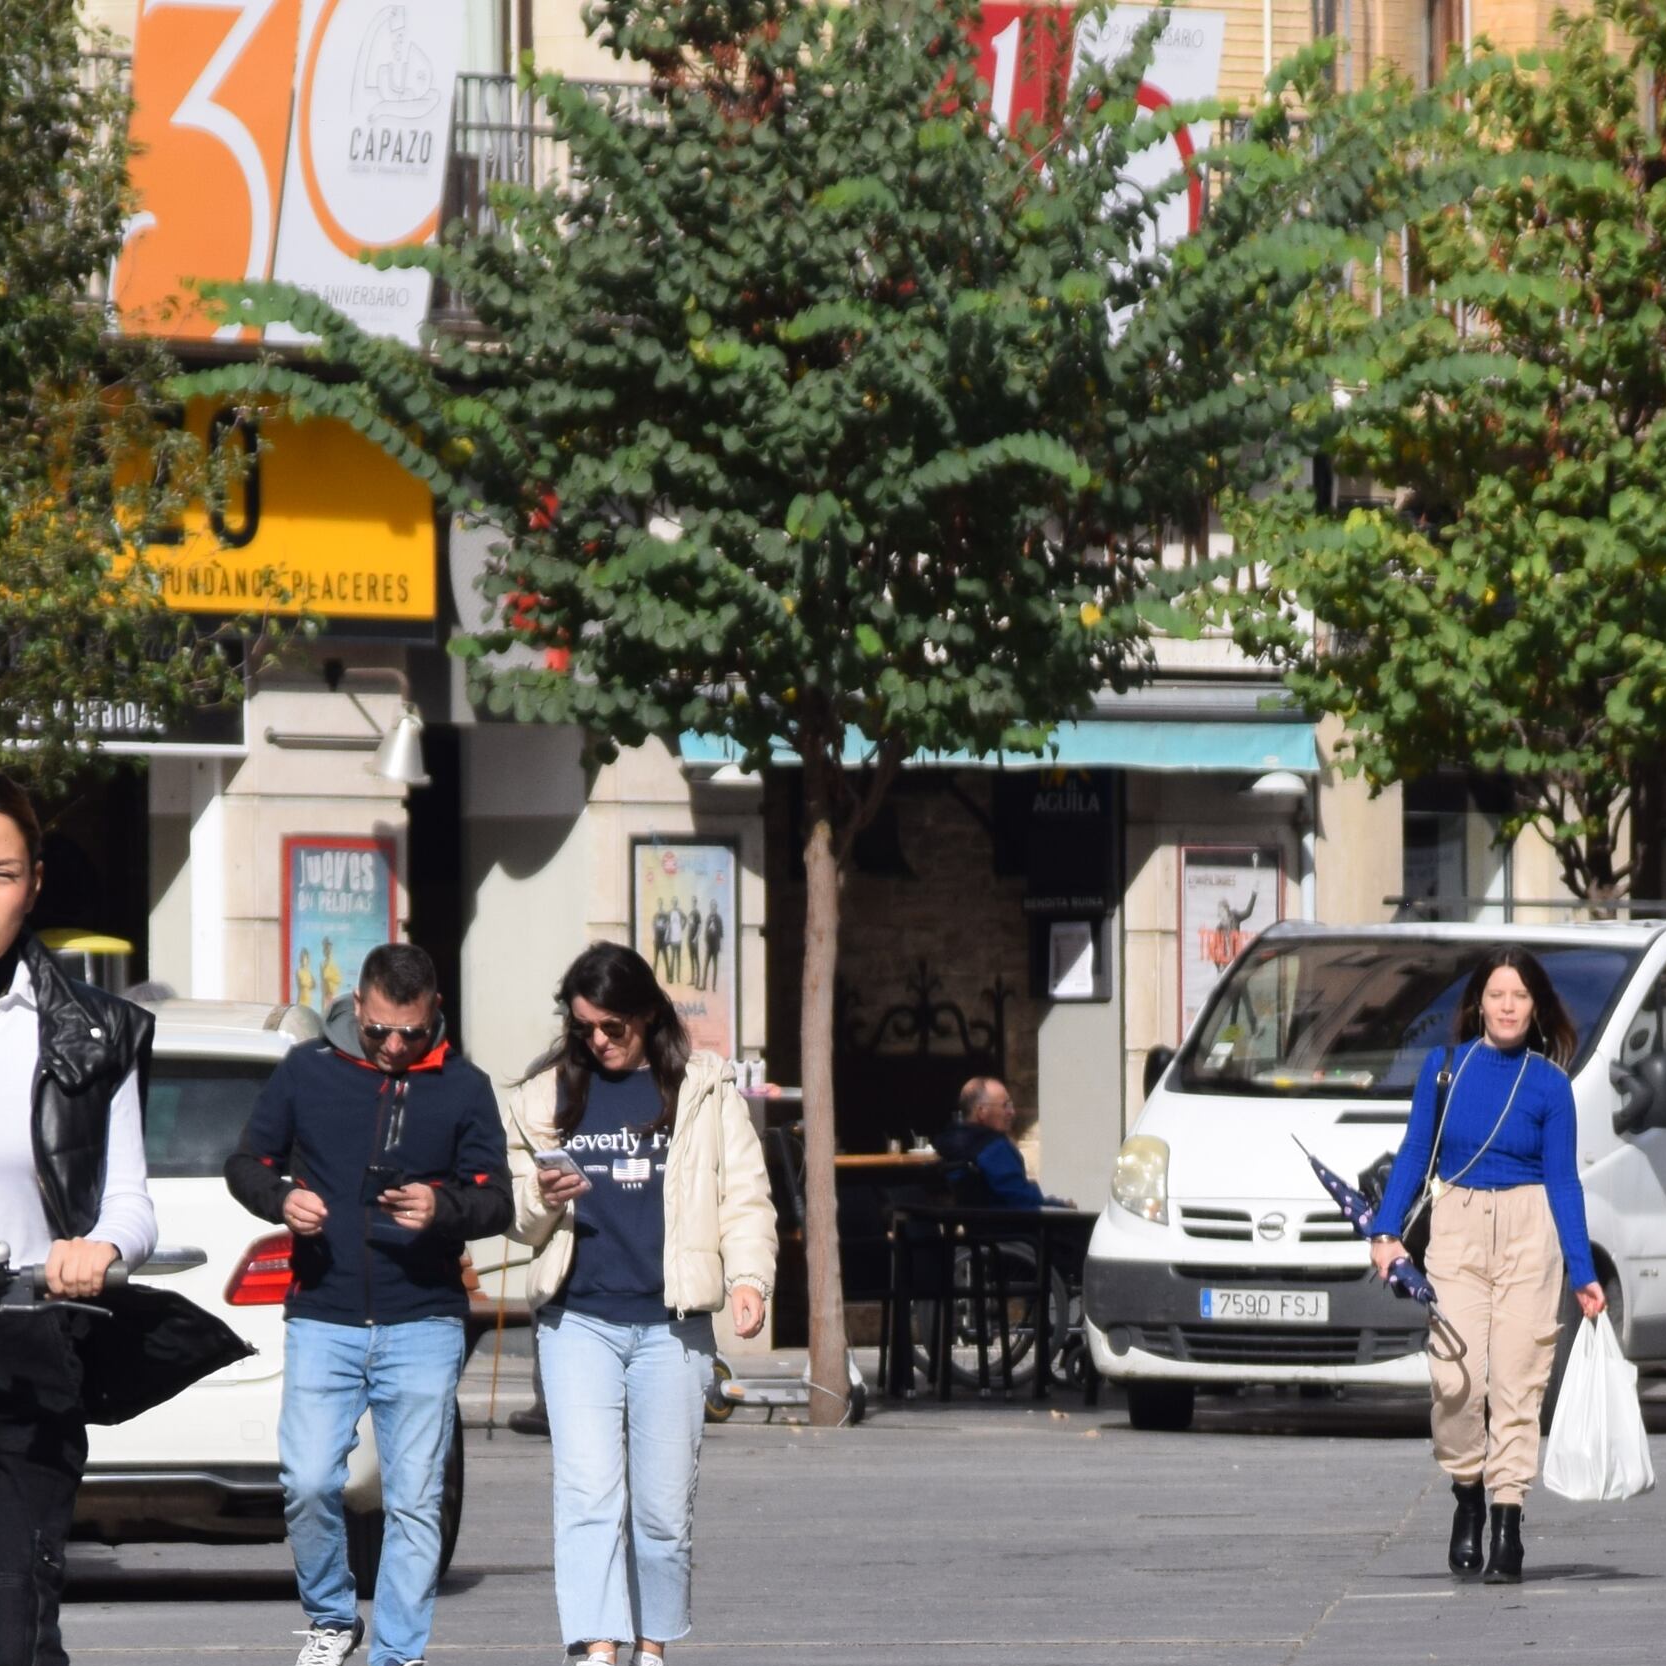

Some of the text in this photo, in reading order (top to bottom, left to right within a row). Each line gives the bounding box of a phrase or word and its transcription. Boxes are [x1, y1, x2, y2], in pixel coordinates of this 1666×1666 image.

[349, 126, 432, 164] CAPAZO
[321, 282, 409, 308] ANIVERSARIO
[291, 567, 409, 604] PLACERES
[1219, 1292, 1319, 1318] 7590 FSJ
